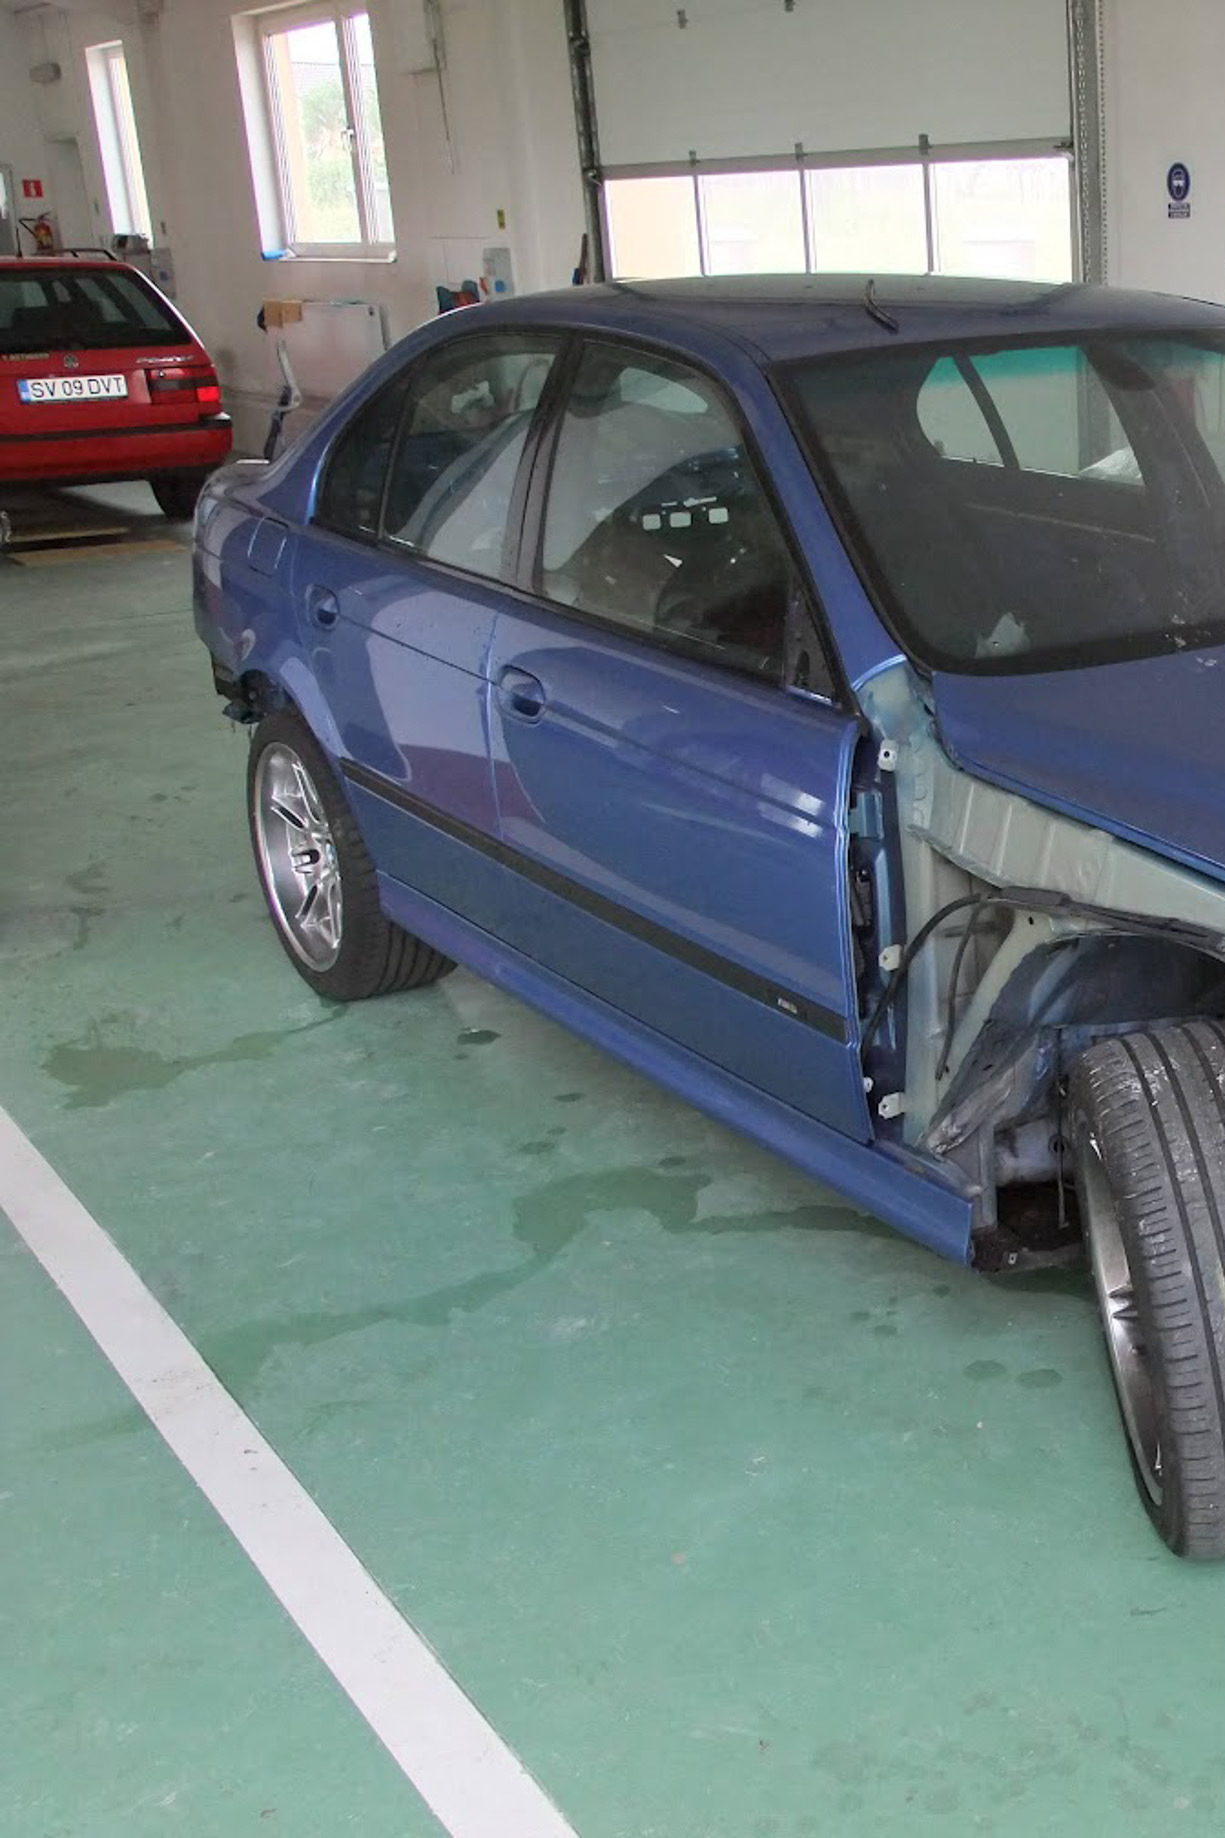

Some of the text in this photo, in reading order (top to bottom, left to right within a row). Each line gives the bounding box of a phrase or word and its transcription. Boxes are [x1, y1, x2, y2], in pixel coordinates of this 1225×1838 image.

[31, 381, 56, 398] SV
[62, 380, 83, 396] 09
[88, 377, 122, 394] DVT
